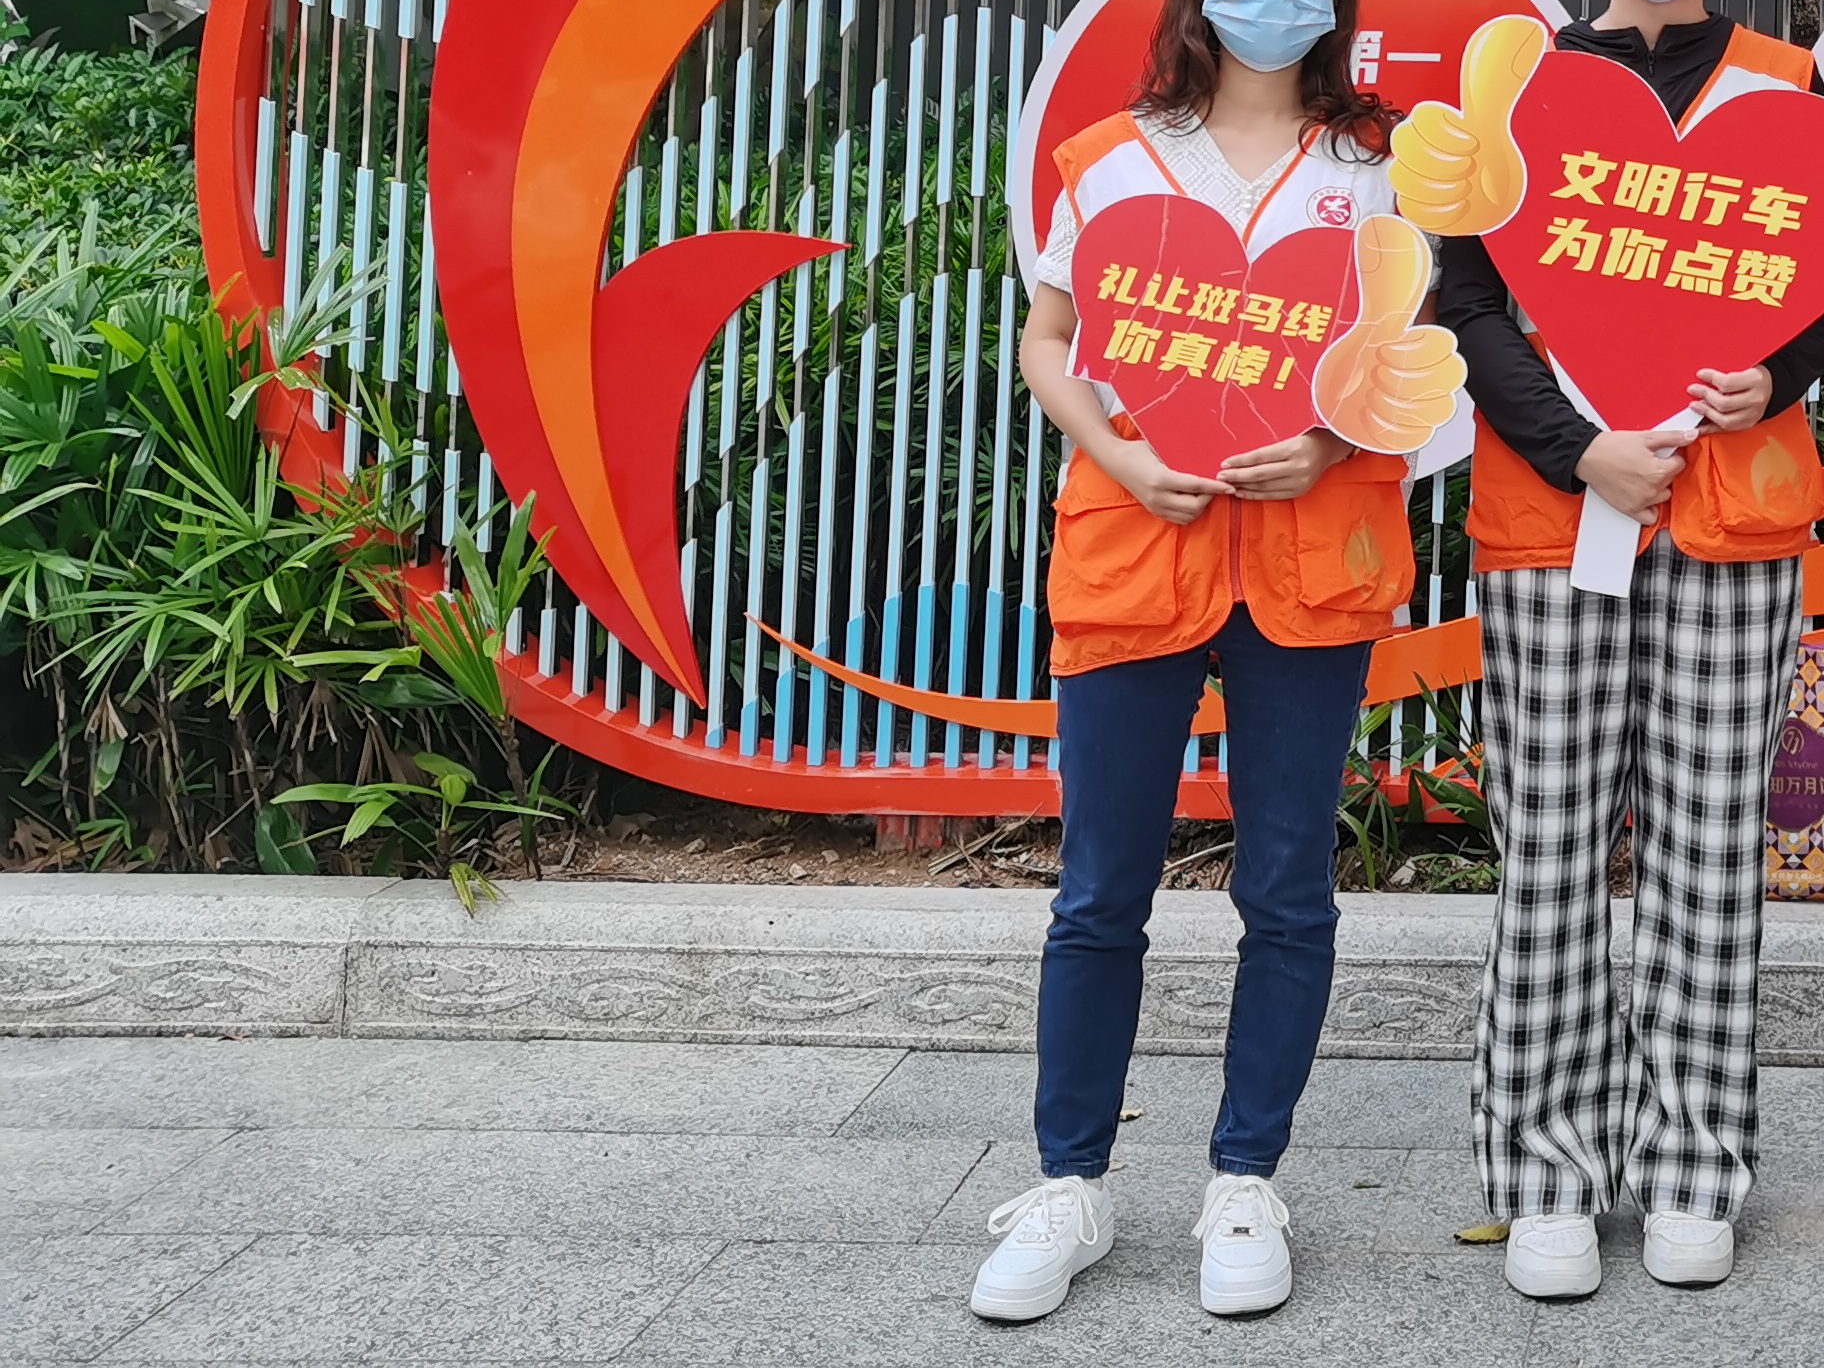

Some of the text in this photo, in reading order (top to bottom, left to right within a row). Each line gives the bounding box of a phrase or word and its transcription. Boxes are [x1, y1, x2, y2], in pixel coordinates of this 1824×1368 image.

[1550, 150, 1810, 237] 文明行车
[1097, 263, 1334, 343] 礼让斑马线
[1537, 216, 1799, 309] 为你点赞
[1103, 318, 1296, 391] 你真棒！
